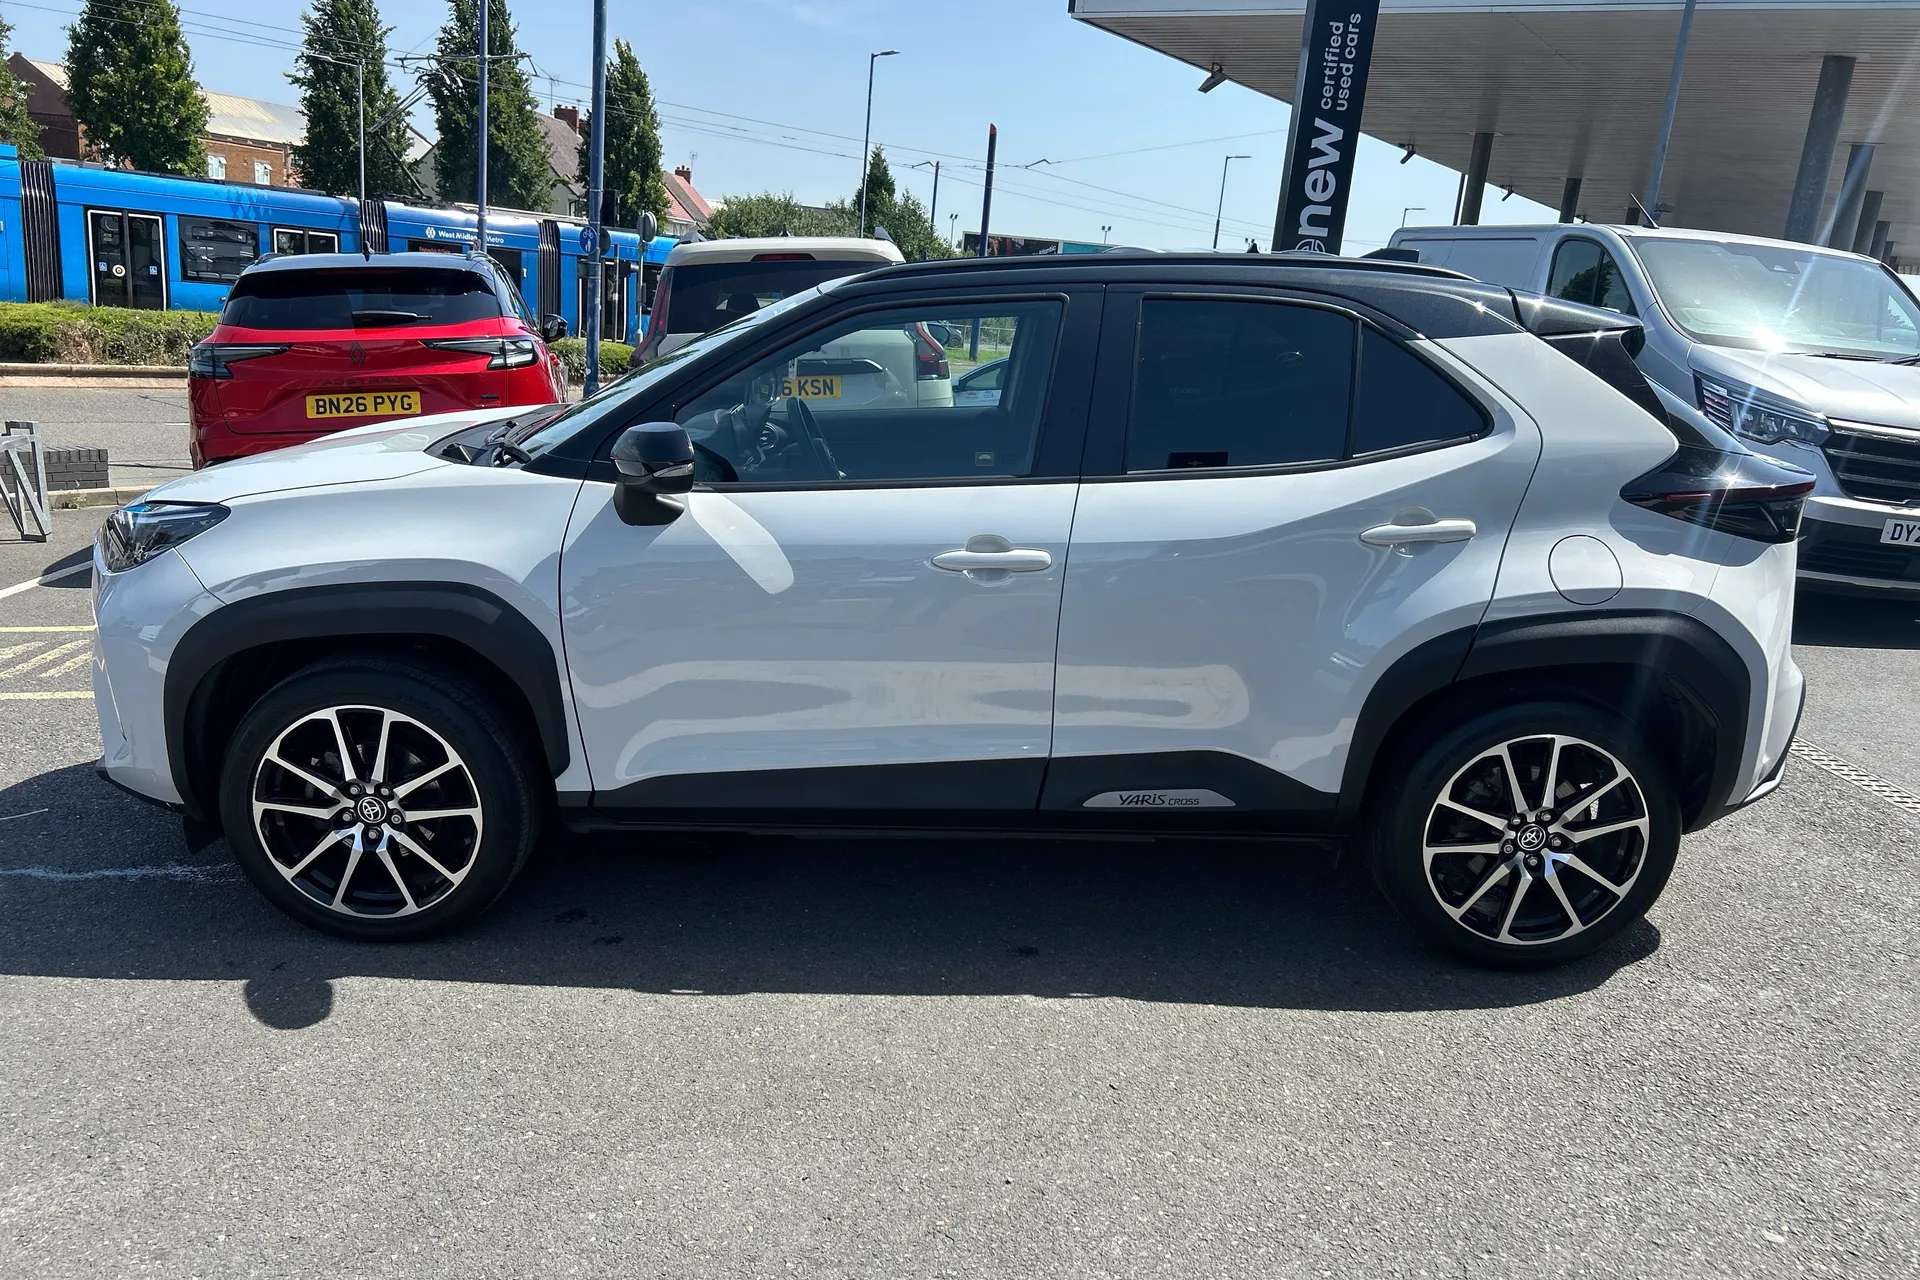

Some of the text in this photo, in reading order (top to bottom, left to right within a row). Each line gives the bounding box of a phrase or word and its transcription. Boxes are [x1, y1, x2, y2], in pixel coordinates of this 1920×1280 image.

[1321, 21, 1344, 110] certified
[1336, 13, 1361, 111] used cars
[438, 230, 455, 239] West
[456, 232, 478, 241] Midlan
[797, 378, 835, 397] KSN
[315, 394, 413, 415] BN26 PYG
[1168, 798, 1200, 806] CROSS
